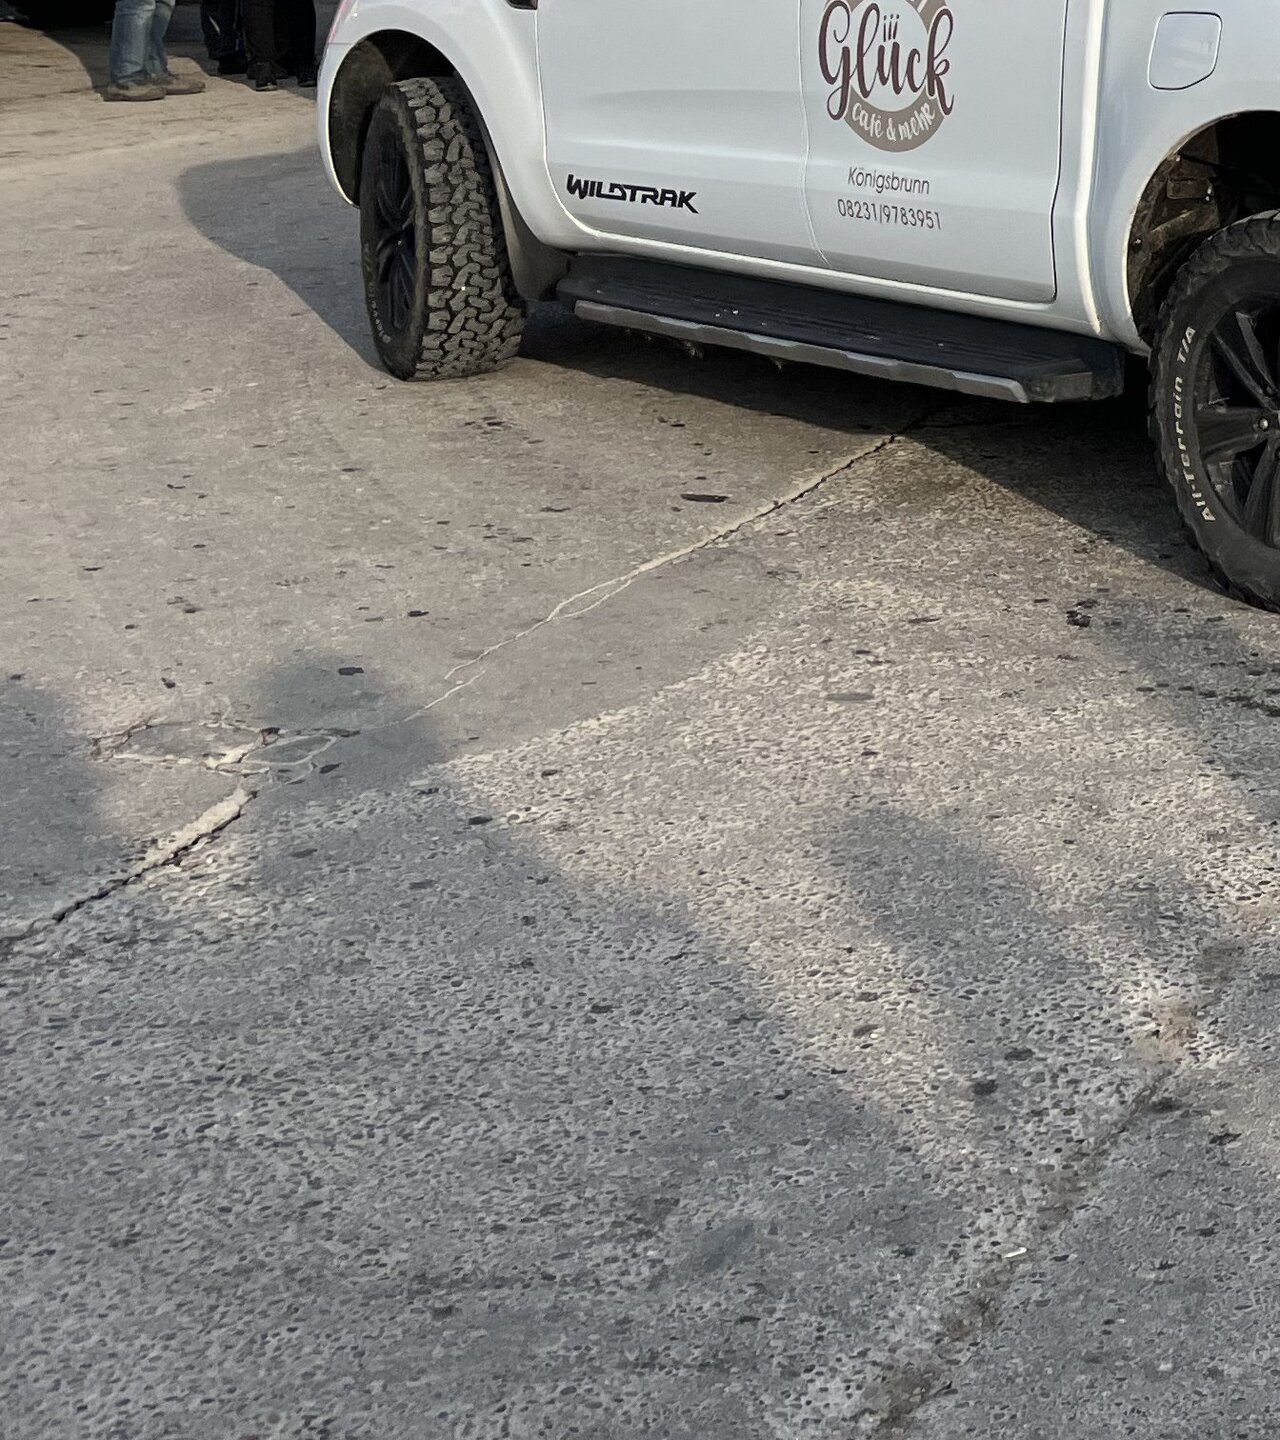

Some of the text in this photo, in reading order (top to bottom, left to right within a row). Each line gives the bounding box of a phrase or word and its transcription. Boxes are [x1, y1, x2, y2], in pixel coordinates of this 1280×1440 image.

[817, 0, 955, 121] Glück
[851, 101, 883, 139] café
[566, 173, 700, 215] WILDTRAK
[847, 166, 930, 195] Königsbrunn
